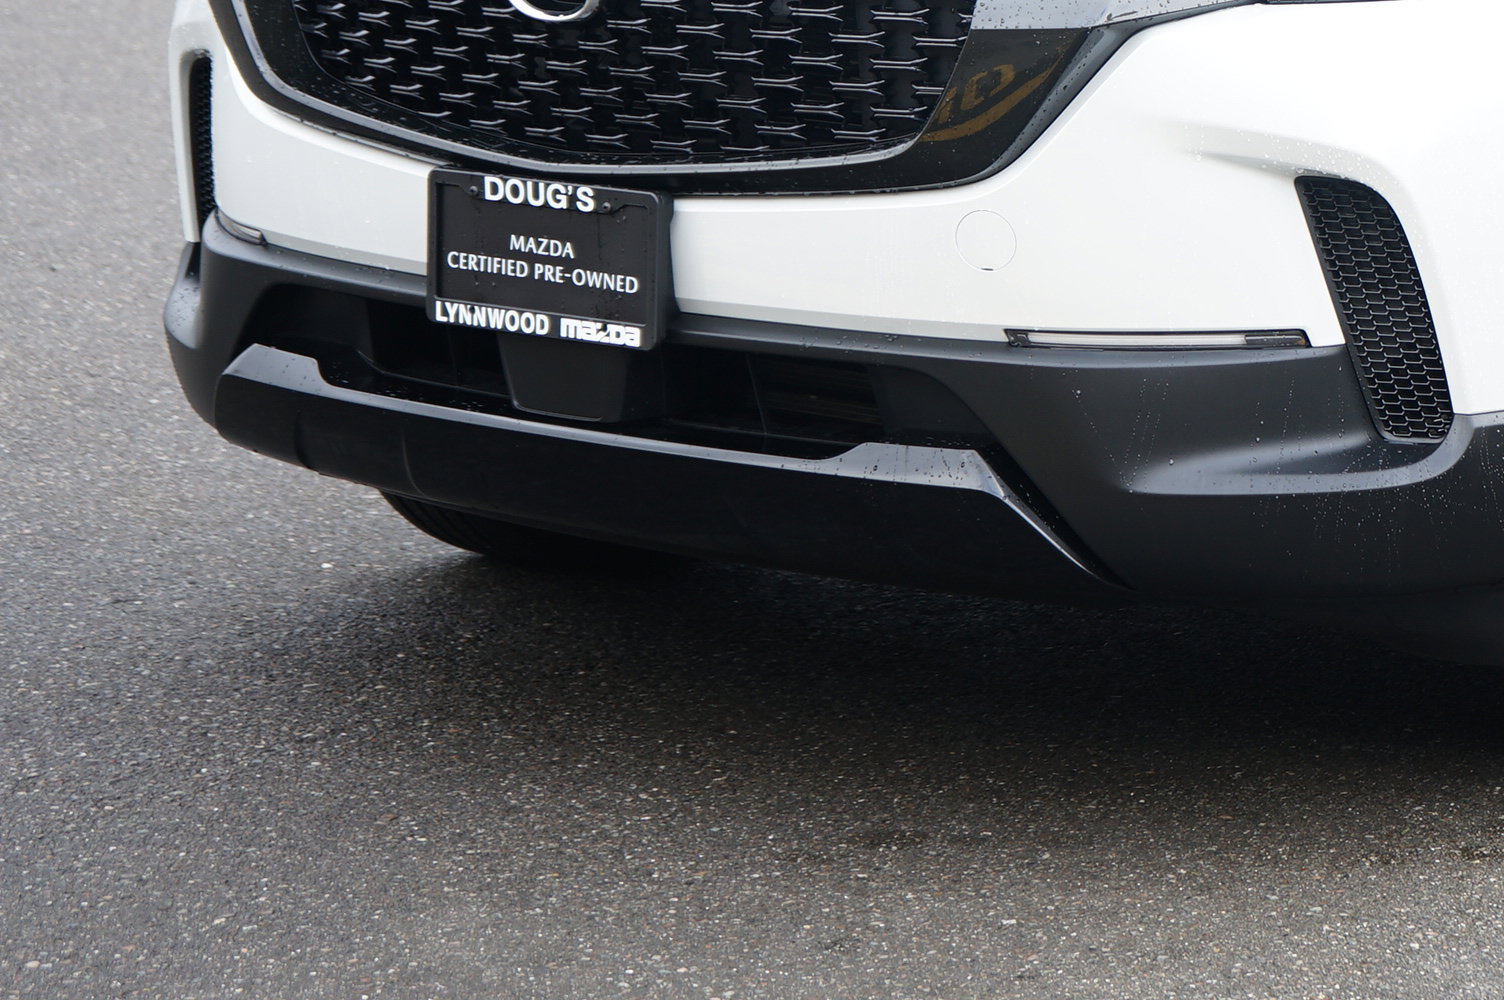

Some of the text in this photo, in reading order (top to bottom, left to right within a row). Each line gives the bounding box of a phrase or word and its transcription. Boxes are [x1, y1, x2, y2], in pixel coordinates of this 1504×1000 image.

[483, 175, 596, 213] DOUG'S
[509, 234, 575, 259] MAZDA
[447, 251, 639, 295] CERTIFIED PRE-OWNED
[435, 300, 550, 336] LYNNWOOD
